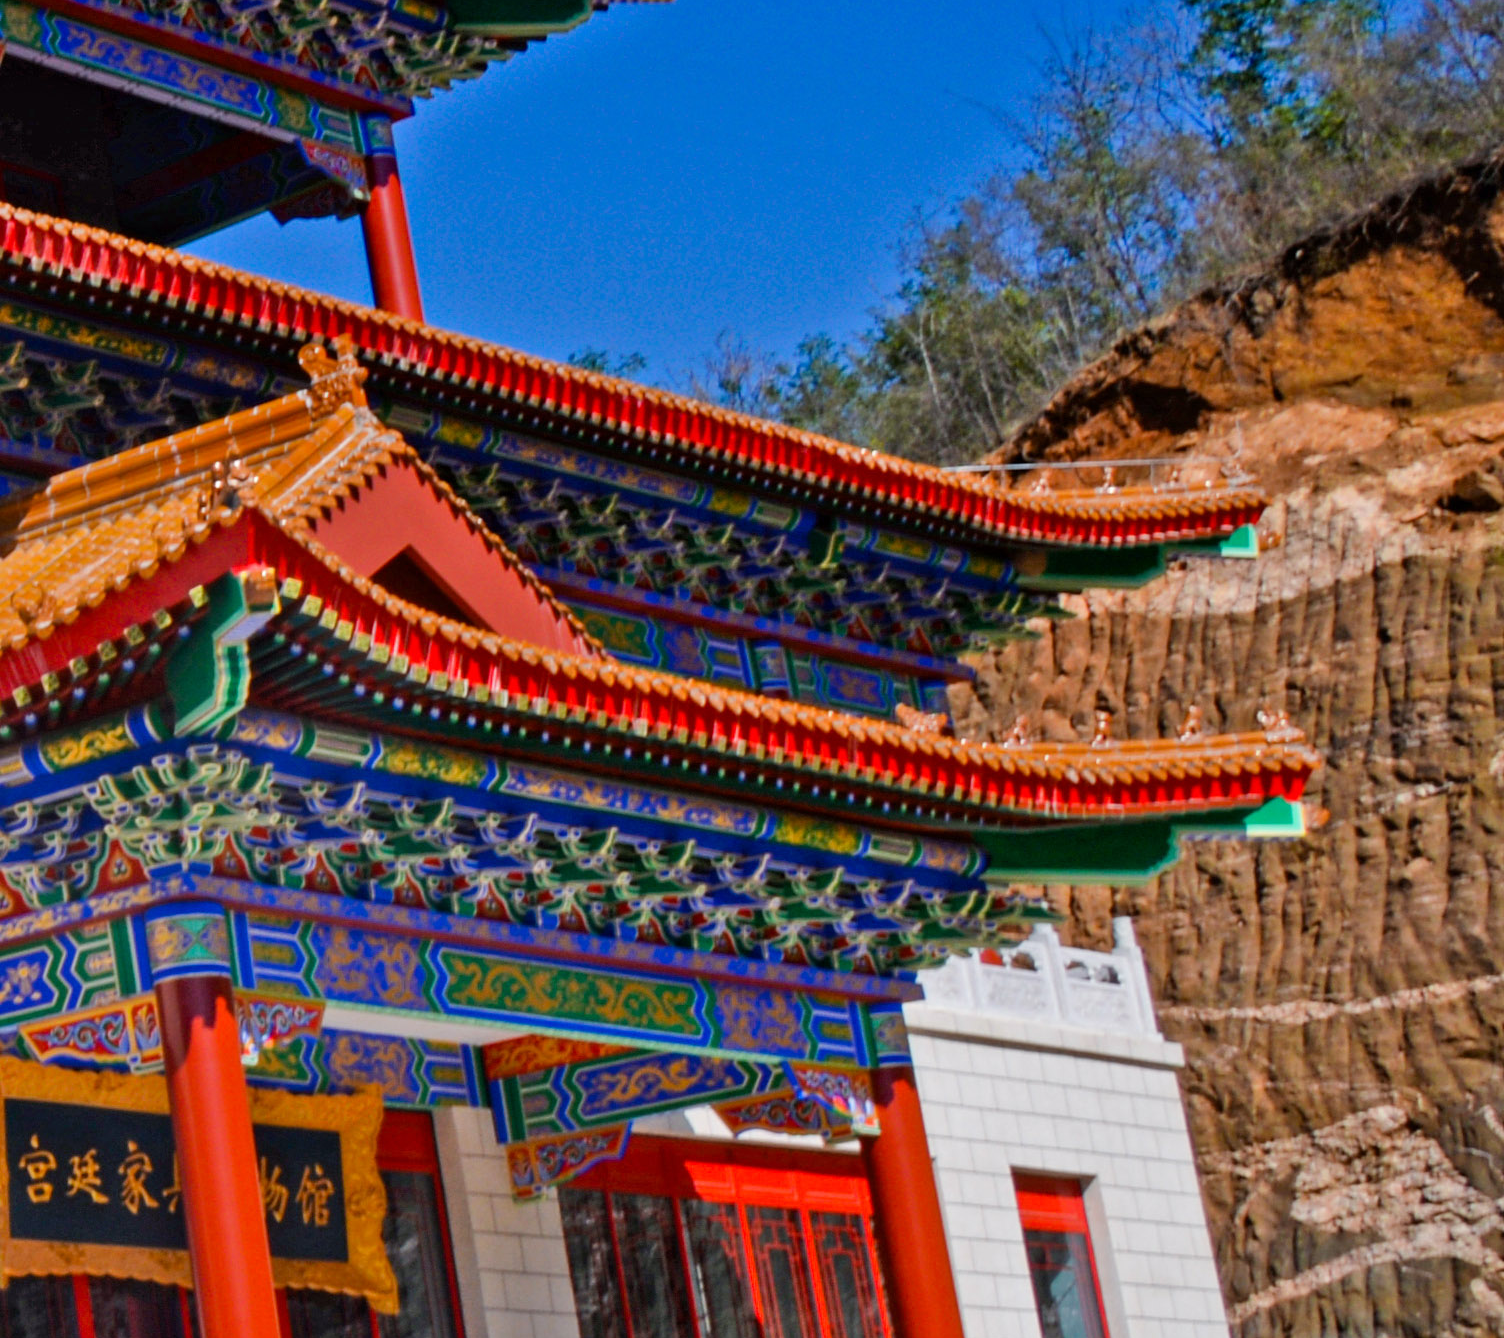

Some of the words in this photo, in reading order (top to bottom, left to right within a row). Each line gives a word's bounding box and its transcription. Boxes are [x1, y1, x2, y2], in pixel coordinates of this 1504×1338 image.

[18, 1133, 335, 1227] 宫廷家物馆
